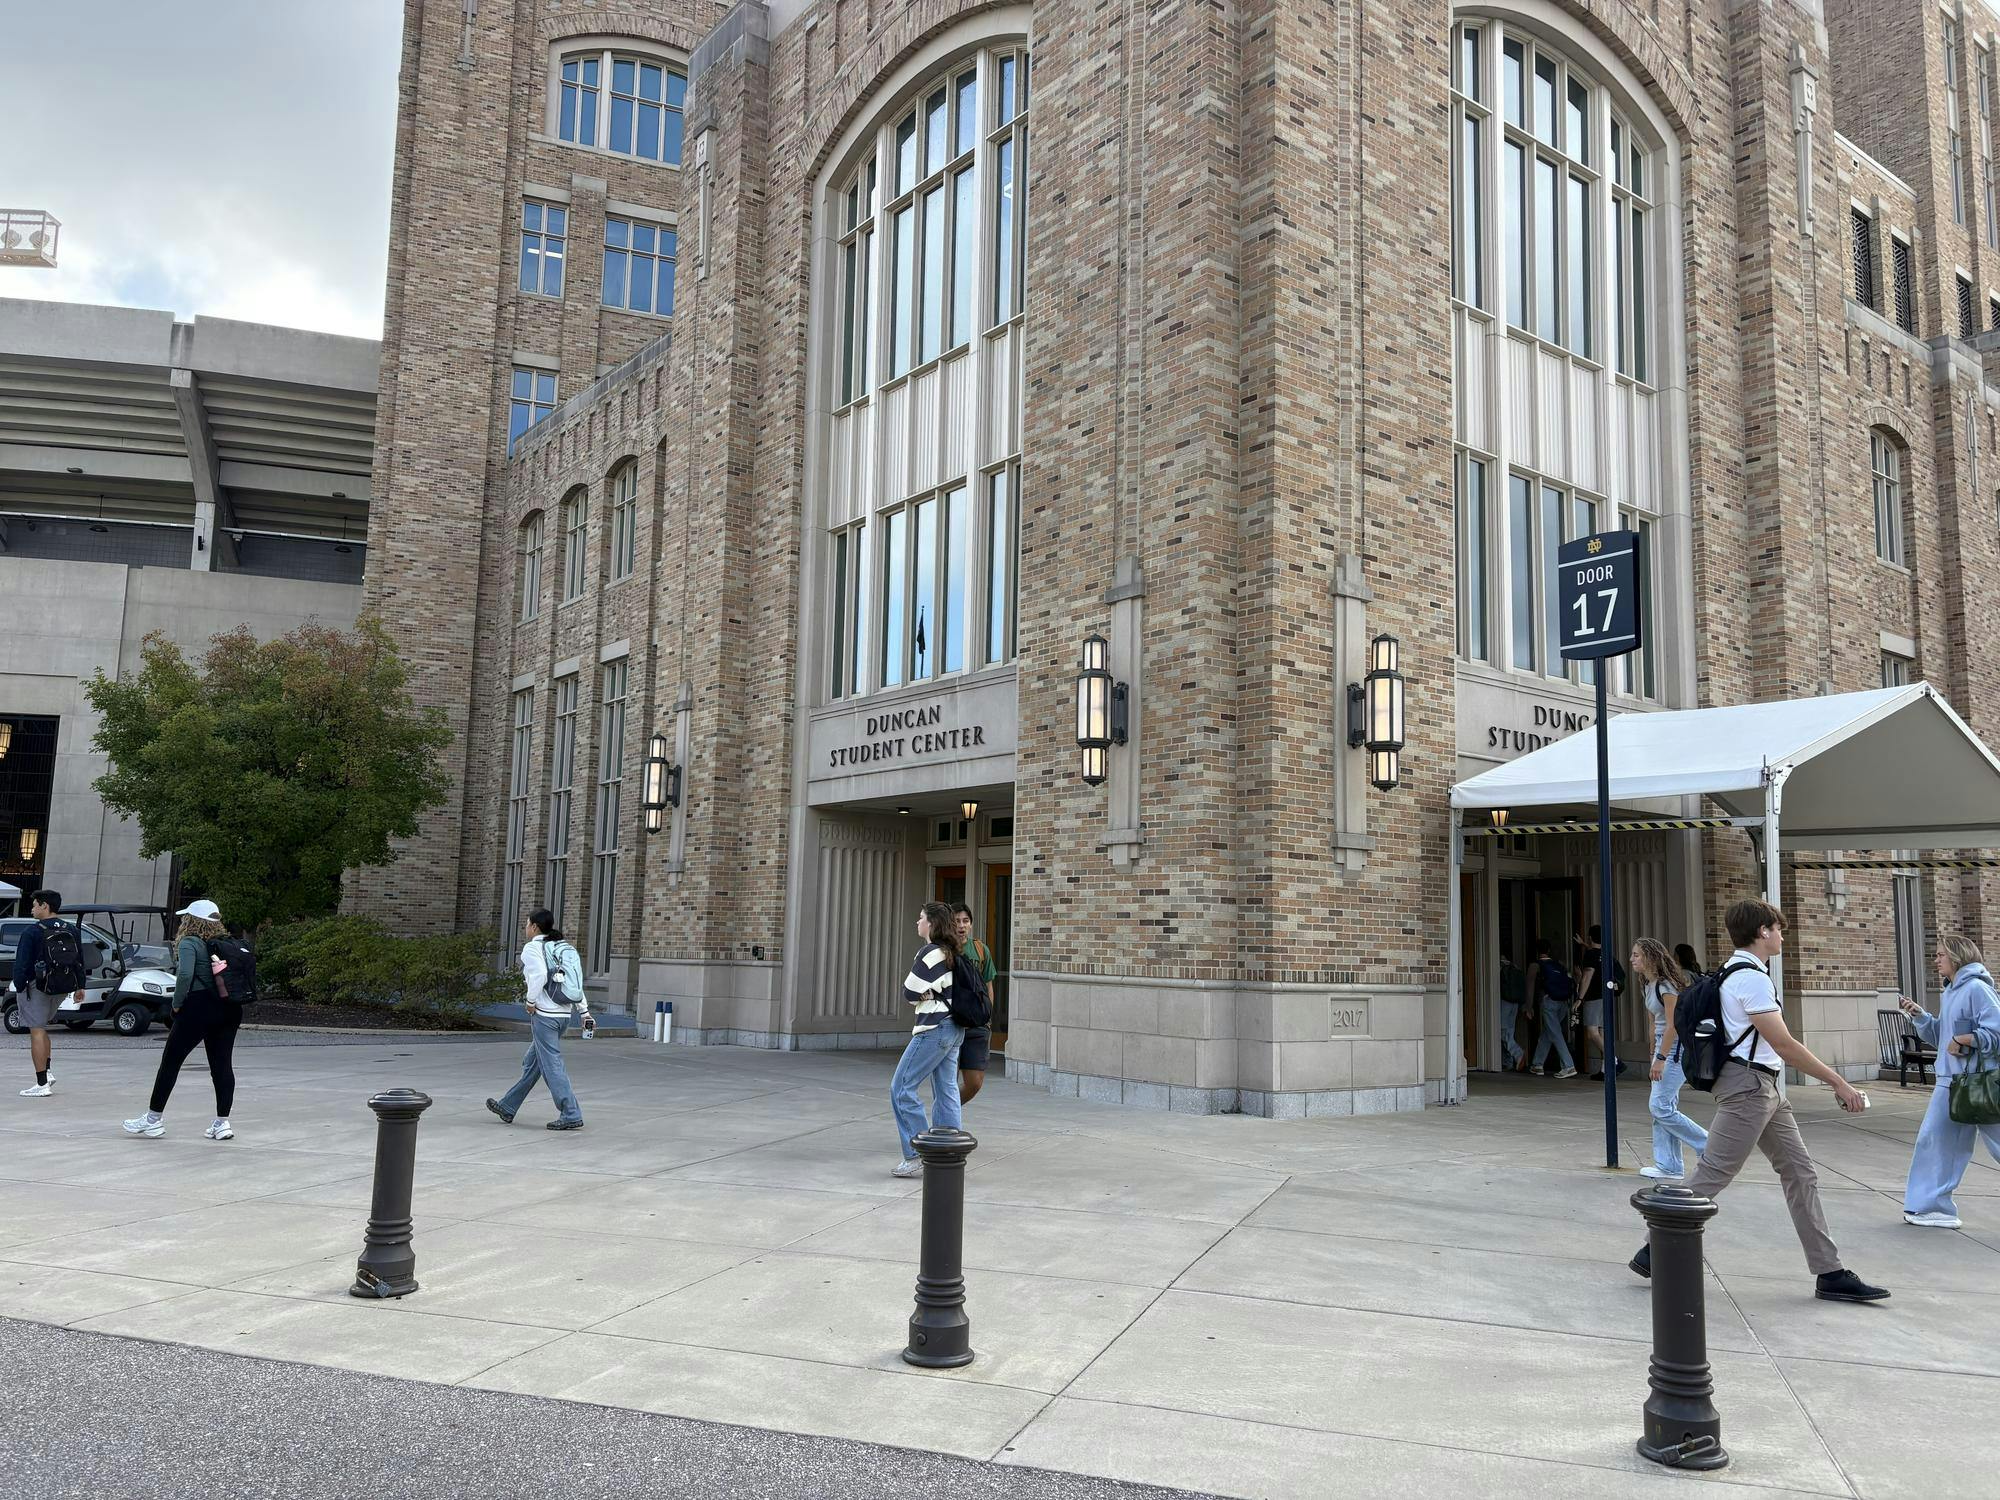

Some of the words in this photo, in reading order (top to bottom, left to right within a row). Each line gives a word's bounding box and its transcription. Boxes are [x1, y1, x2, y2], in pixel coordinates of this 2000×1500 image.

[1577, 565, 1613, 585] DOOR
[1573, 588, 1618, 636] 17
[867, 705, 941, 736] DUNCAN
[1534, 705, 1597, 731] DUNC
[830, 738, 904, 767] STUDENT
[911, 726, 986, 754] CENTER
[1488, 726, 1559, 753] STUD
[1333, 1009, 1363, 1028] 2017
